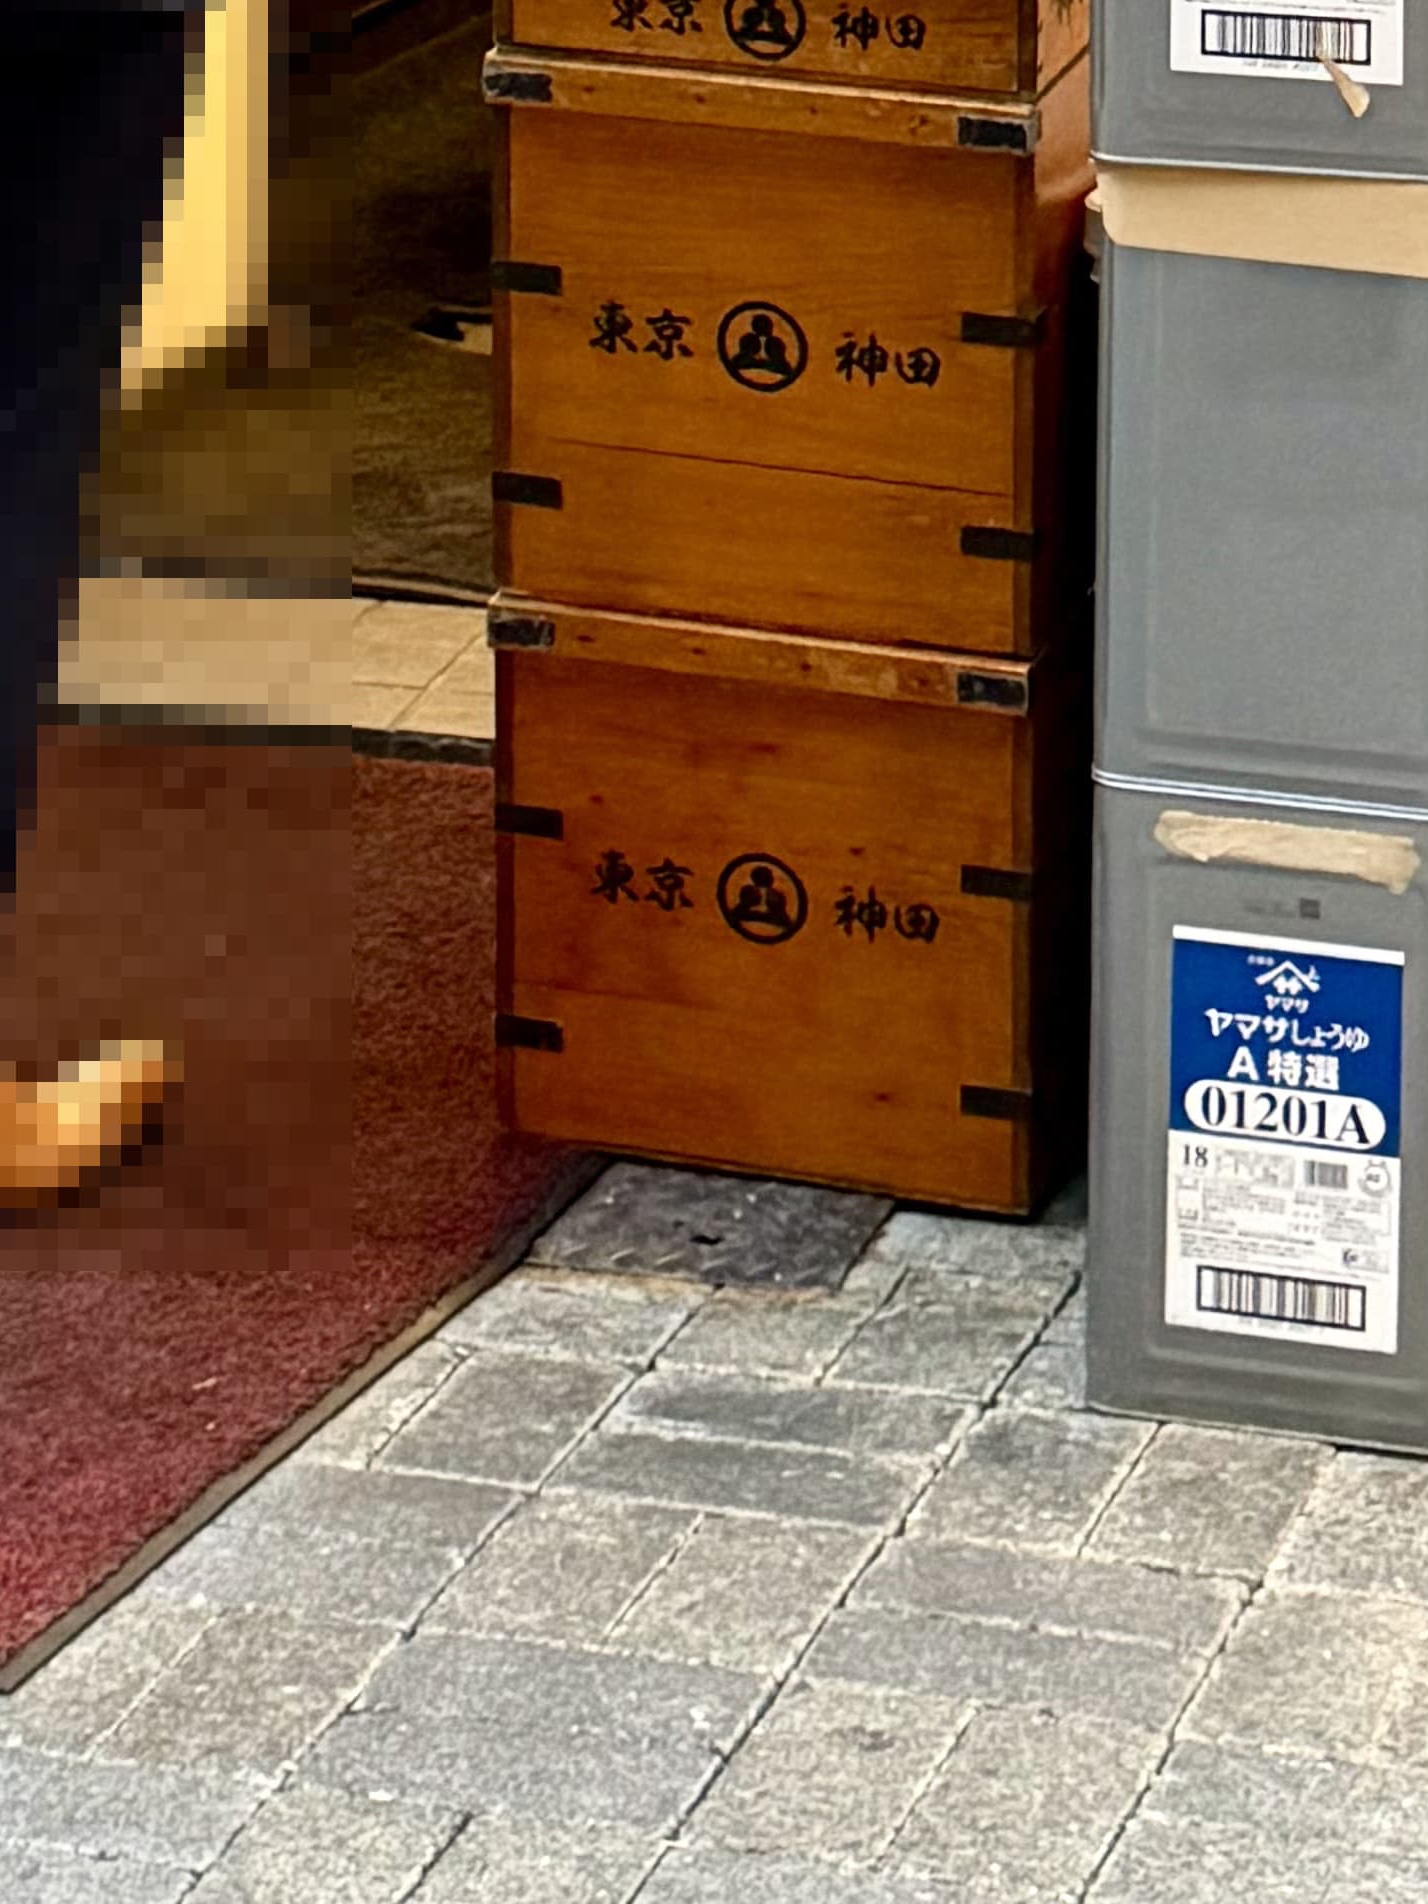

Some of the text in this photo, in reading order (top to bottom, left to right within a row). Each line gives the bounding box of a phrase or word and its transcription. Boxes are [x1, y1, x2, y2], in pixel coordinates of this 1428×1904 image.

[830, 2, 928, 53] 神田
[588, 300, 942, 390] 東京 神田
[589, 849, 942, 945] 東京 神田
[1264, 994, 1310, 1013] ヤマサ
[1203, 1007, 1371, 1054] ヤマサしょうゆ
[1227, 1046, 1340, 1091] A 特選
[1201, 1084, 1372, 1147] 01201A
[1182, 1143, 1209, 1169] 18
